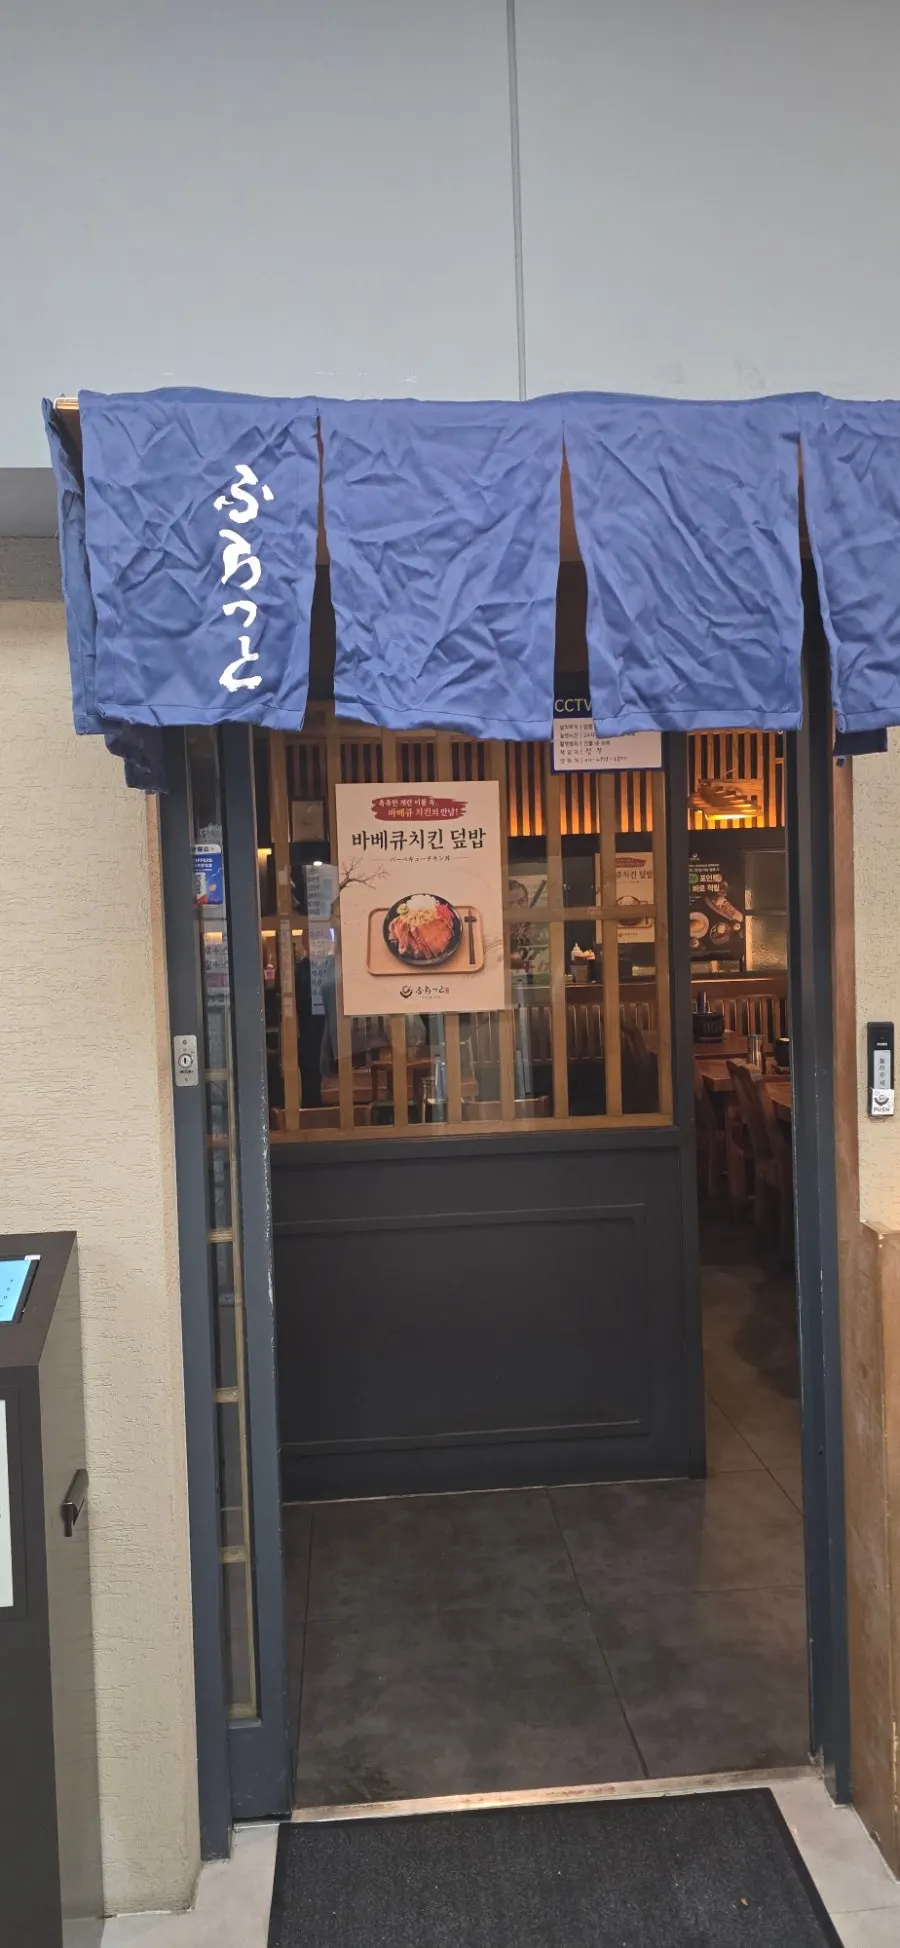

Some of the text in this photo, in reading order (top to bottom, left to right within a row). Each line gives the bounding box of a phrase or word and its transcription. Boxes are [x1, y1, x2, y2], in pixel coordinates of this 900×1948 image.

[213, 464, 275, 692] ふらっと
[555, 698, 592, 712] CCTV
[388, 807, 413, 818] 바베큐
[416, 807, 439, 817] 치킨의
[352, 827, 487, 851] 바베큐치킨 덮밥
